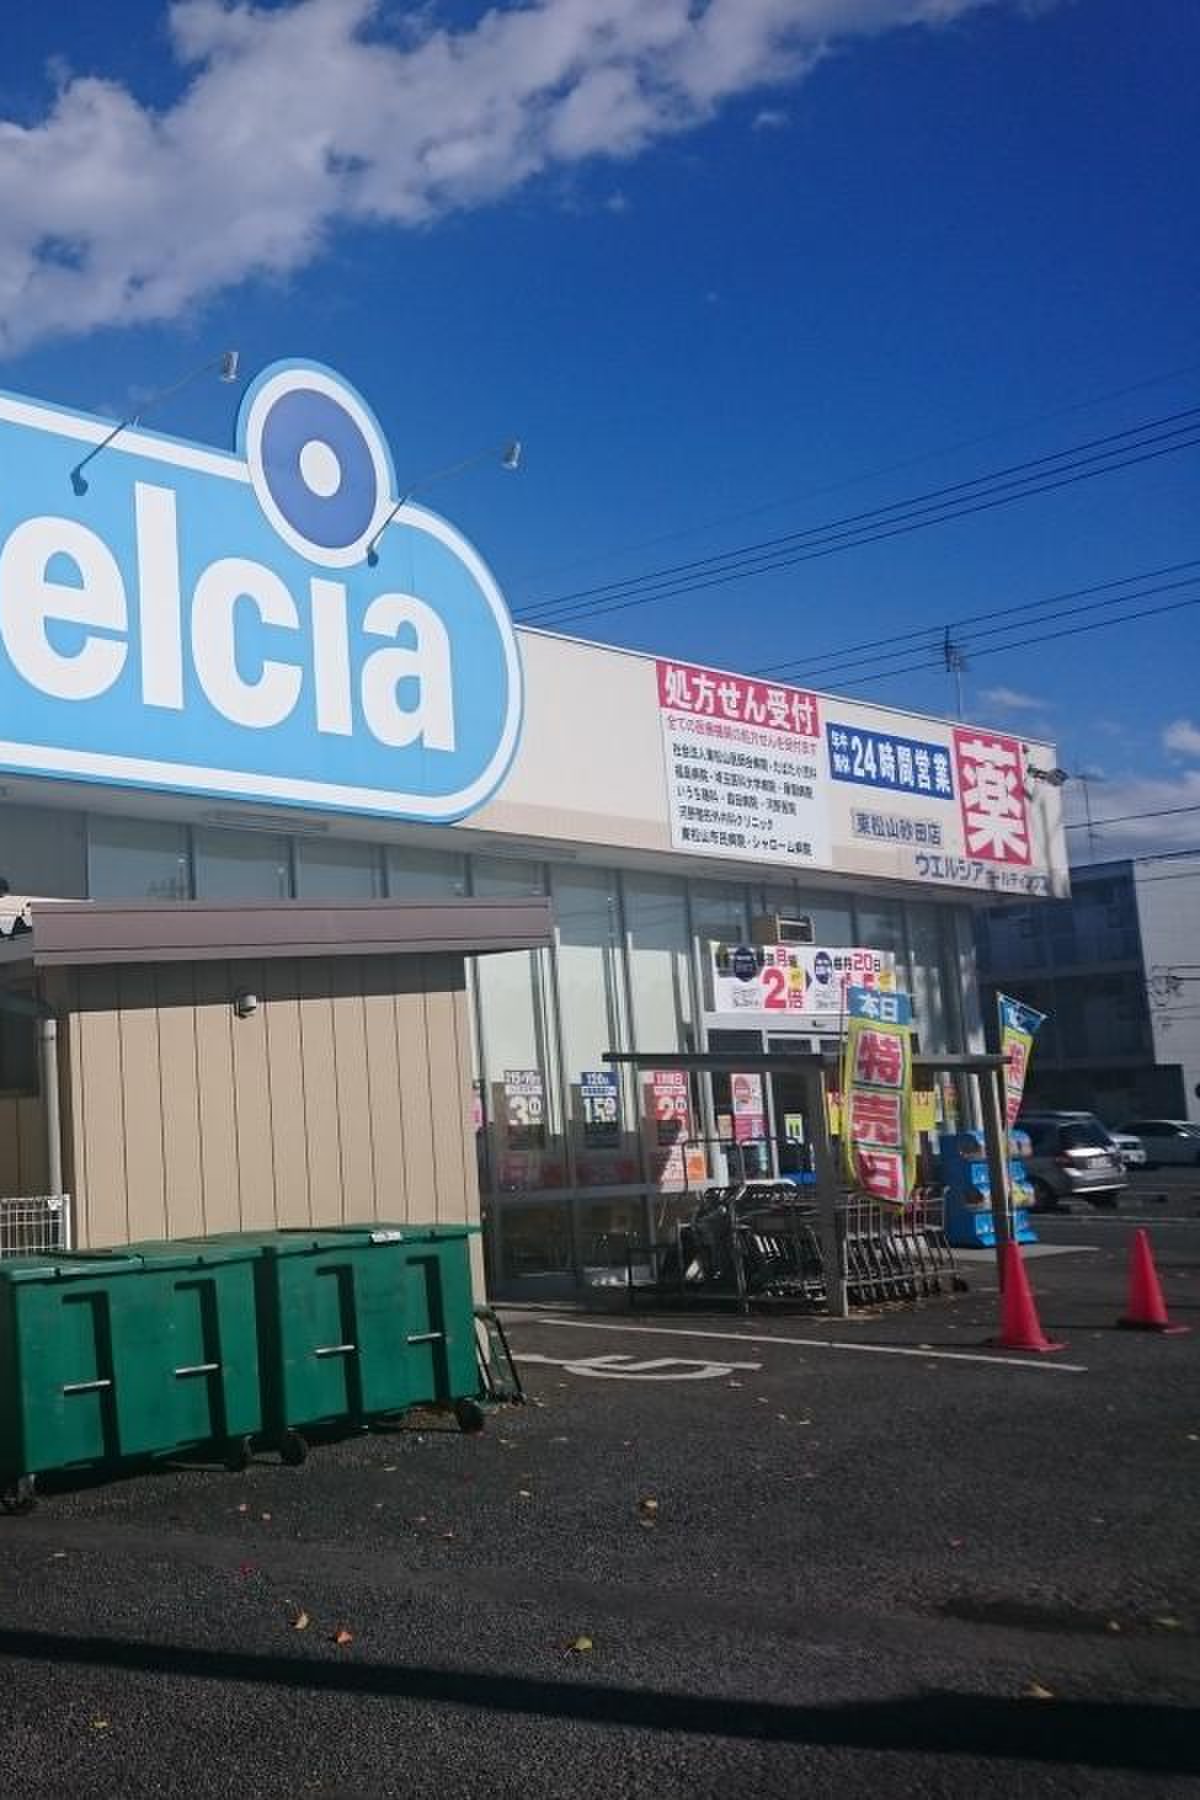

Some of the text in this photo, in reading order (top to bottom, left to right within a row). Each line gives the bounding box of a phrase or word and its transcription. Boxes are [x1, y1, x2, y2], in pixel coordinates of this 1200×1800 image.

[665, 665, 814, 735] 処方せん受付
[851, 736, 950, 793] 24時間営業
[960, 739, 1029, 858] 薬
[856, 812, 943, 846] 東松山砂田店
[860, 992, 898, 1022] 本日
